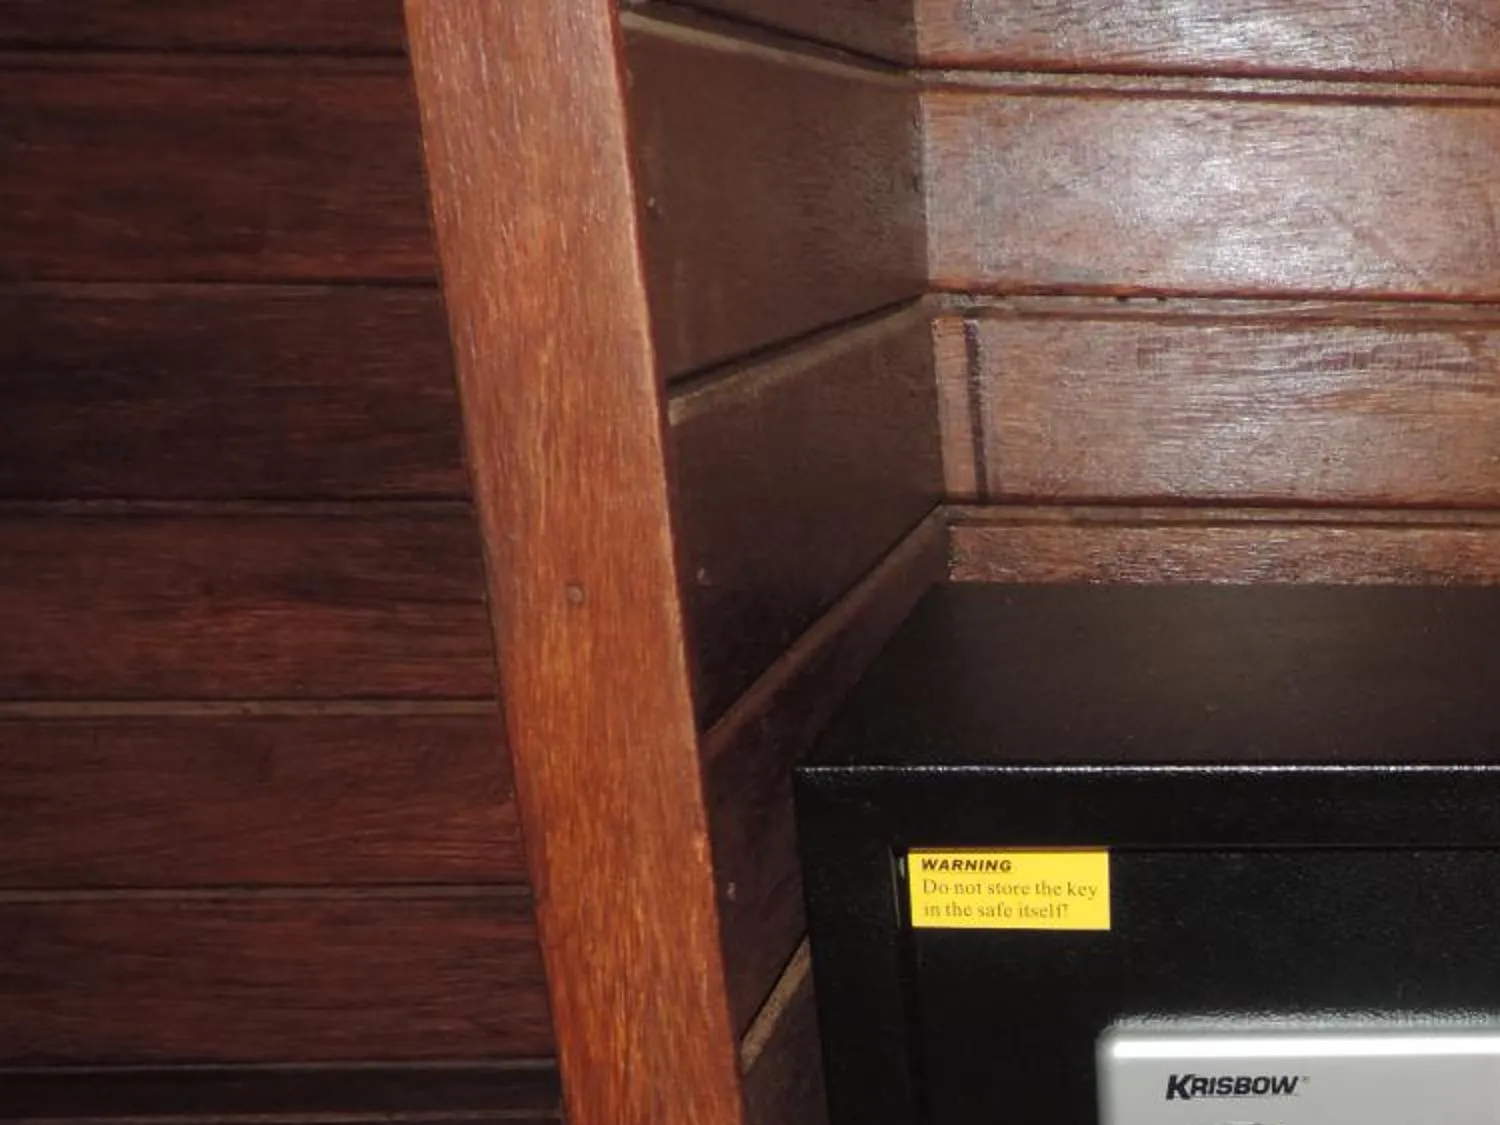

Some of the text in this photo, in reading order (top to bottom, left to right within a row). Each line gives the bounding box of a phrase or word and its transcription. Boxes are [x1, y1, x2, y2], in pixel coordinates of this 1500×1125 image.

[921, 857, 1013, 872] WARNING
[922, 878, 1099, 901] Do not store the key
[923, 902, 941, 917] in
[945, 902, 973, 918] the
[977, 902, 1014, 918] safe
